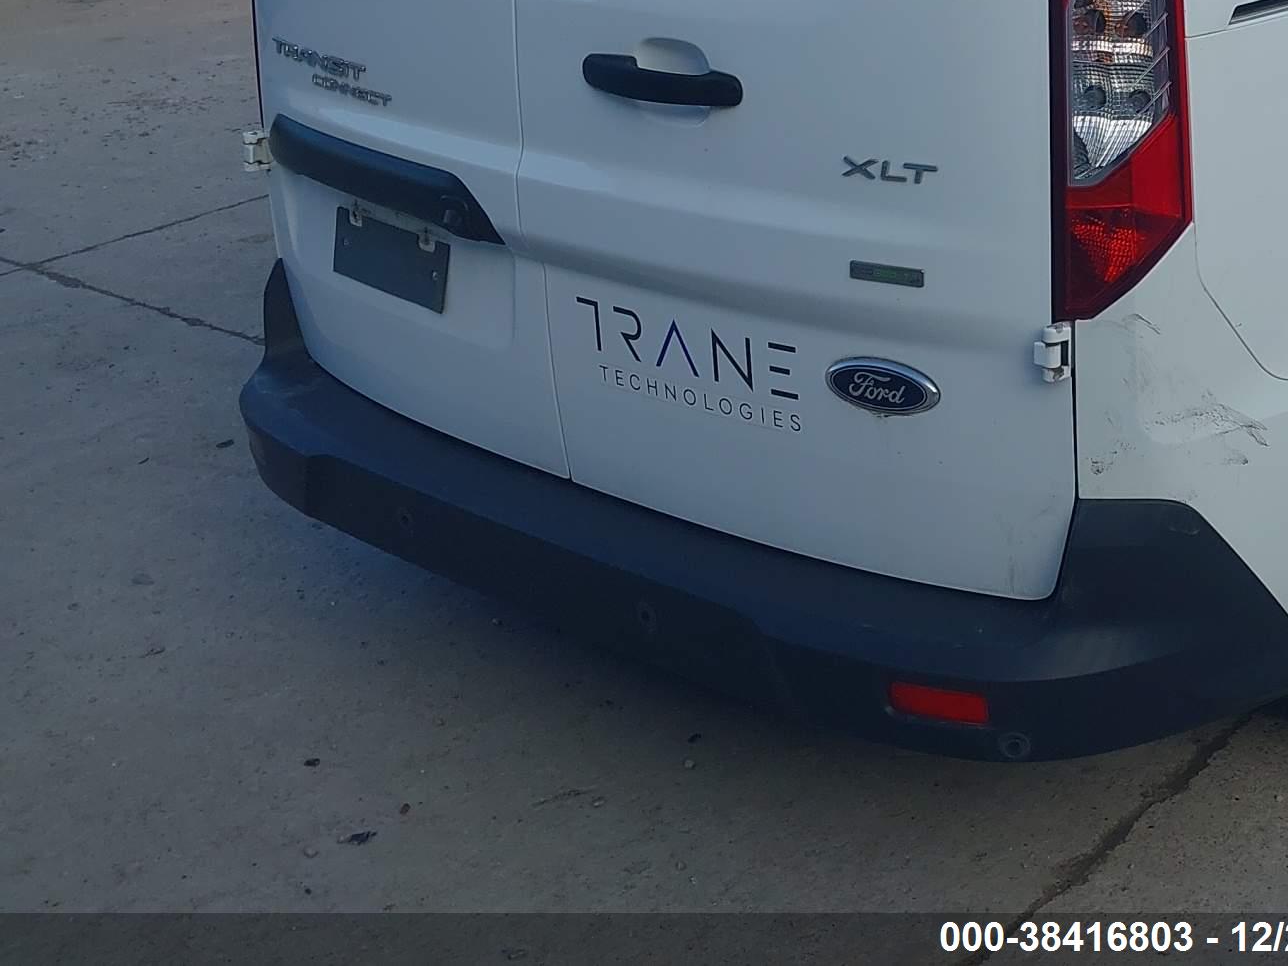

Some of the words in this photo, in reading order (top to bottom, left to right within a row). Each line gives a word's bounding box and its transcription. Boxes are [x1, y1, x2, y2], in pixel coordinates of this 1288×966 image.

[271, 36, 367, 81] TRANSIT
[841, 156, 938, 184] XLT
[576, 296, 799, 401] TRANE
[598, 364, 802, 433] TECHNOLOGIES
[848, 371, 906, 405] Ford
